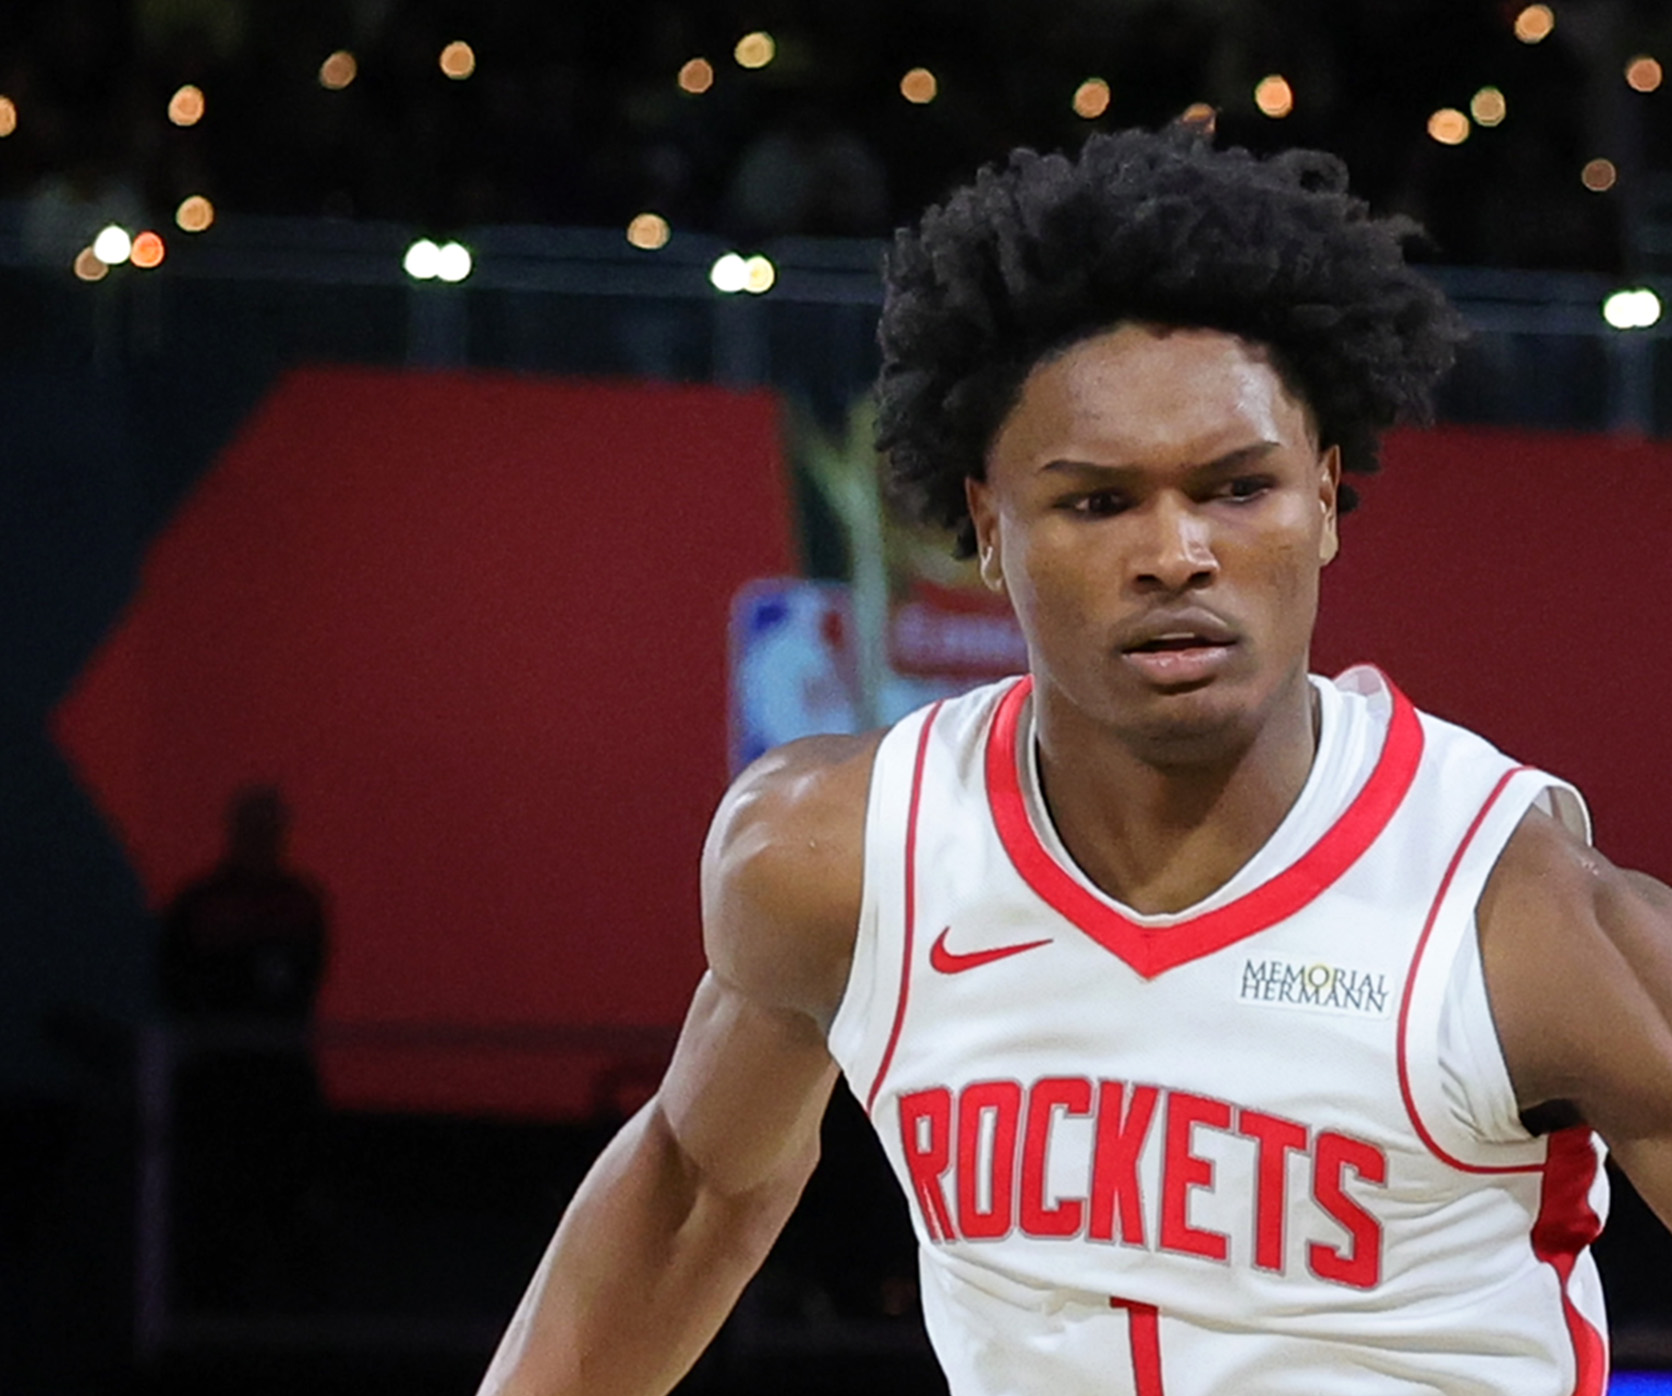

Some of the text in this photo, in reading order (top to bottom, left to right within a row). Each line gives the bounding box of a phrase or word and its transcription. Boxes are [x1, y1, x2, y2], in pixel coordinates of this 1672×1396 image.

[1239, 975, 1390, 1013] HERMANN
[1242, 958, 1390, 996] MEMORIAL
[895, 1075, 1390, 1292] ROCKETS
